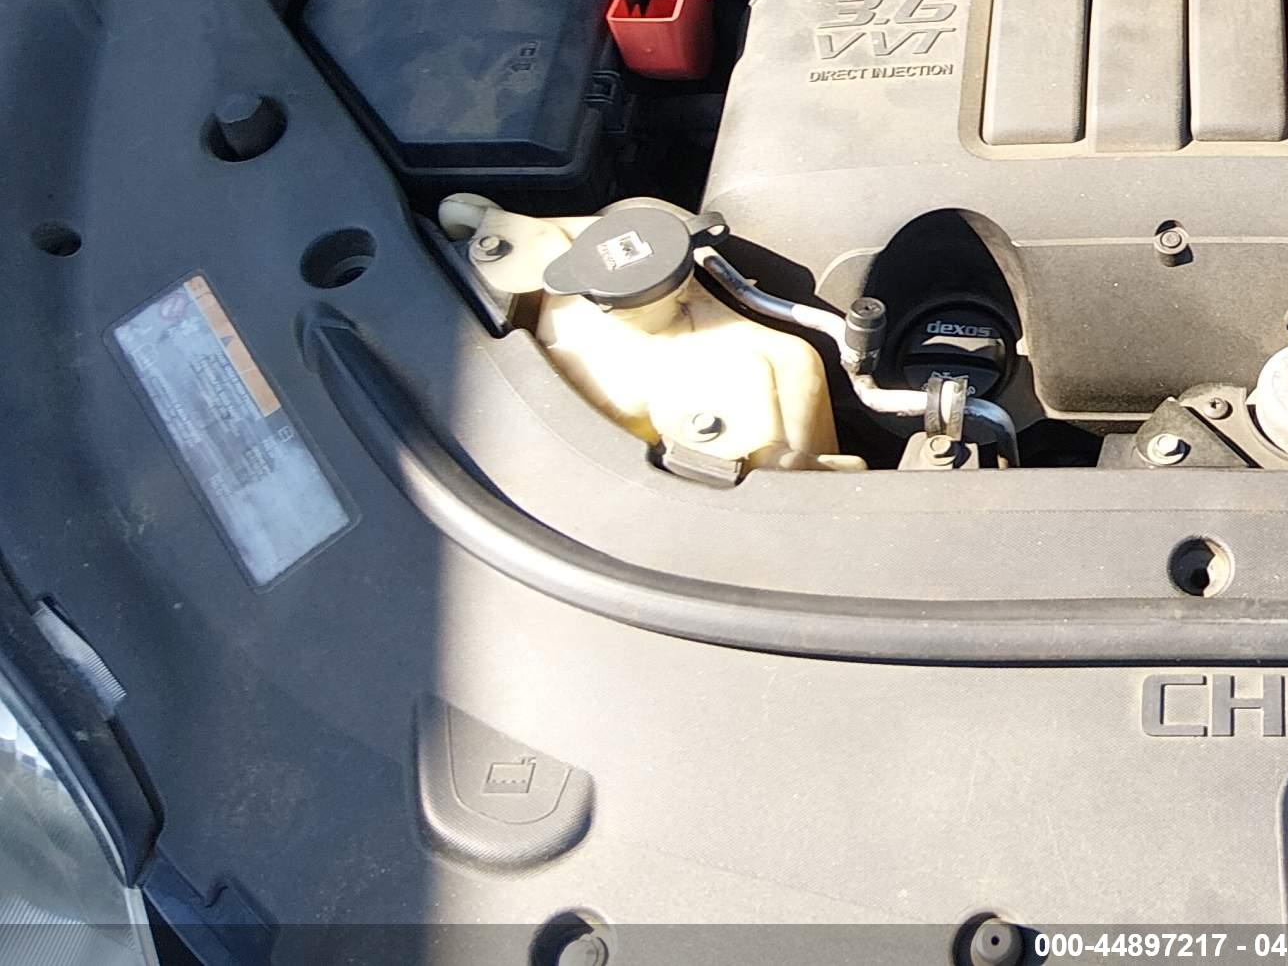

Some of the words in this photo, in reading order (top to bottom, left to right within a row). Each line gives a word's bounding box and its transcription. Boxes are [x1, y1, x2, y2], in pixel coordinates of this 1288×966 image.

[815, 27, 957, 59] VVT
[809, 68, 868, 83] DIRECT
[871, 64, 954, 80] INJECTION
[926, 320, 992, 337] dexos
